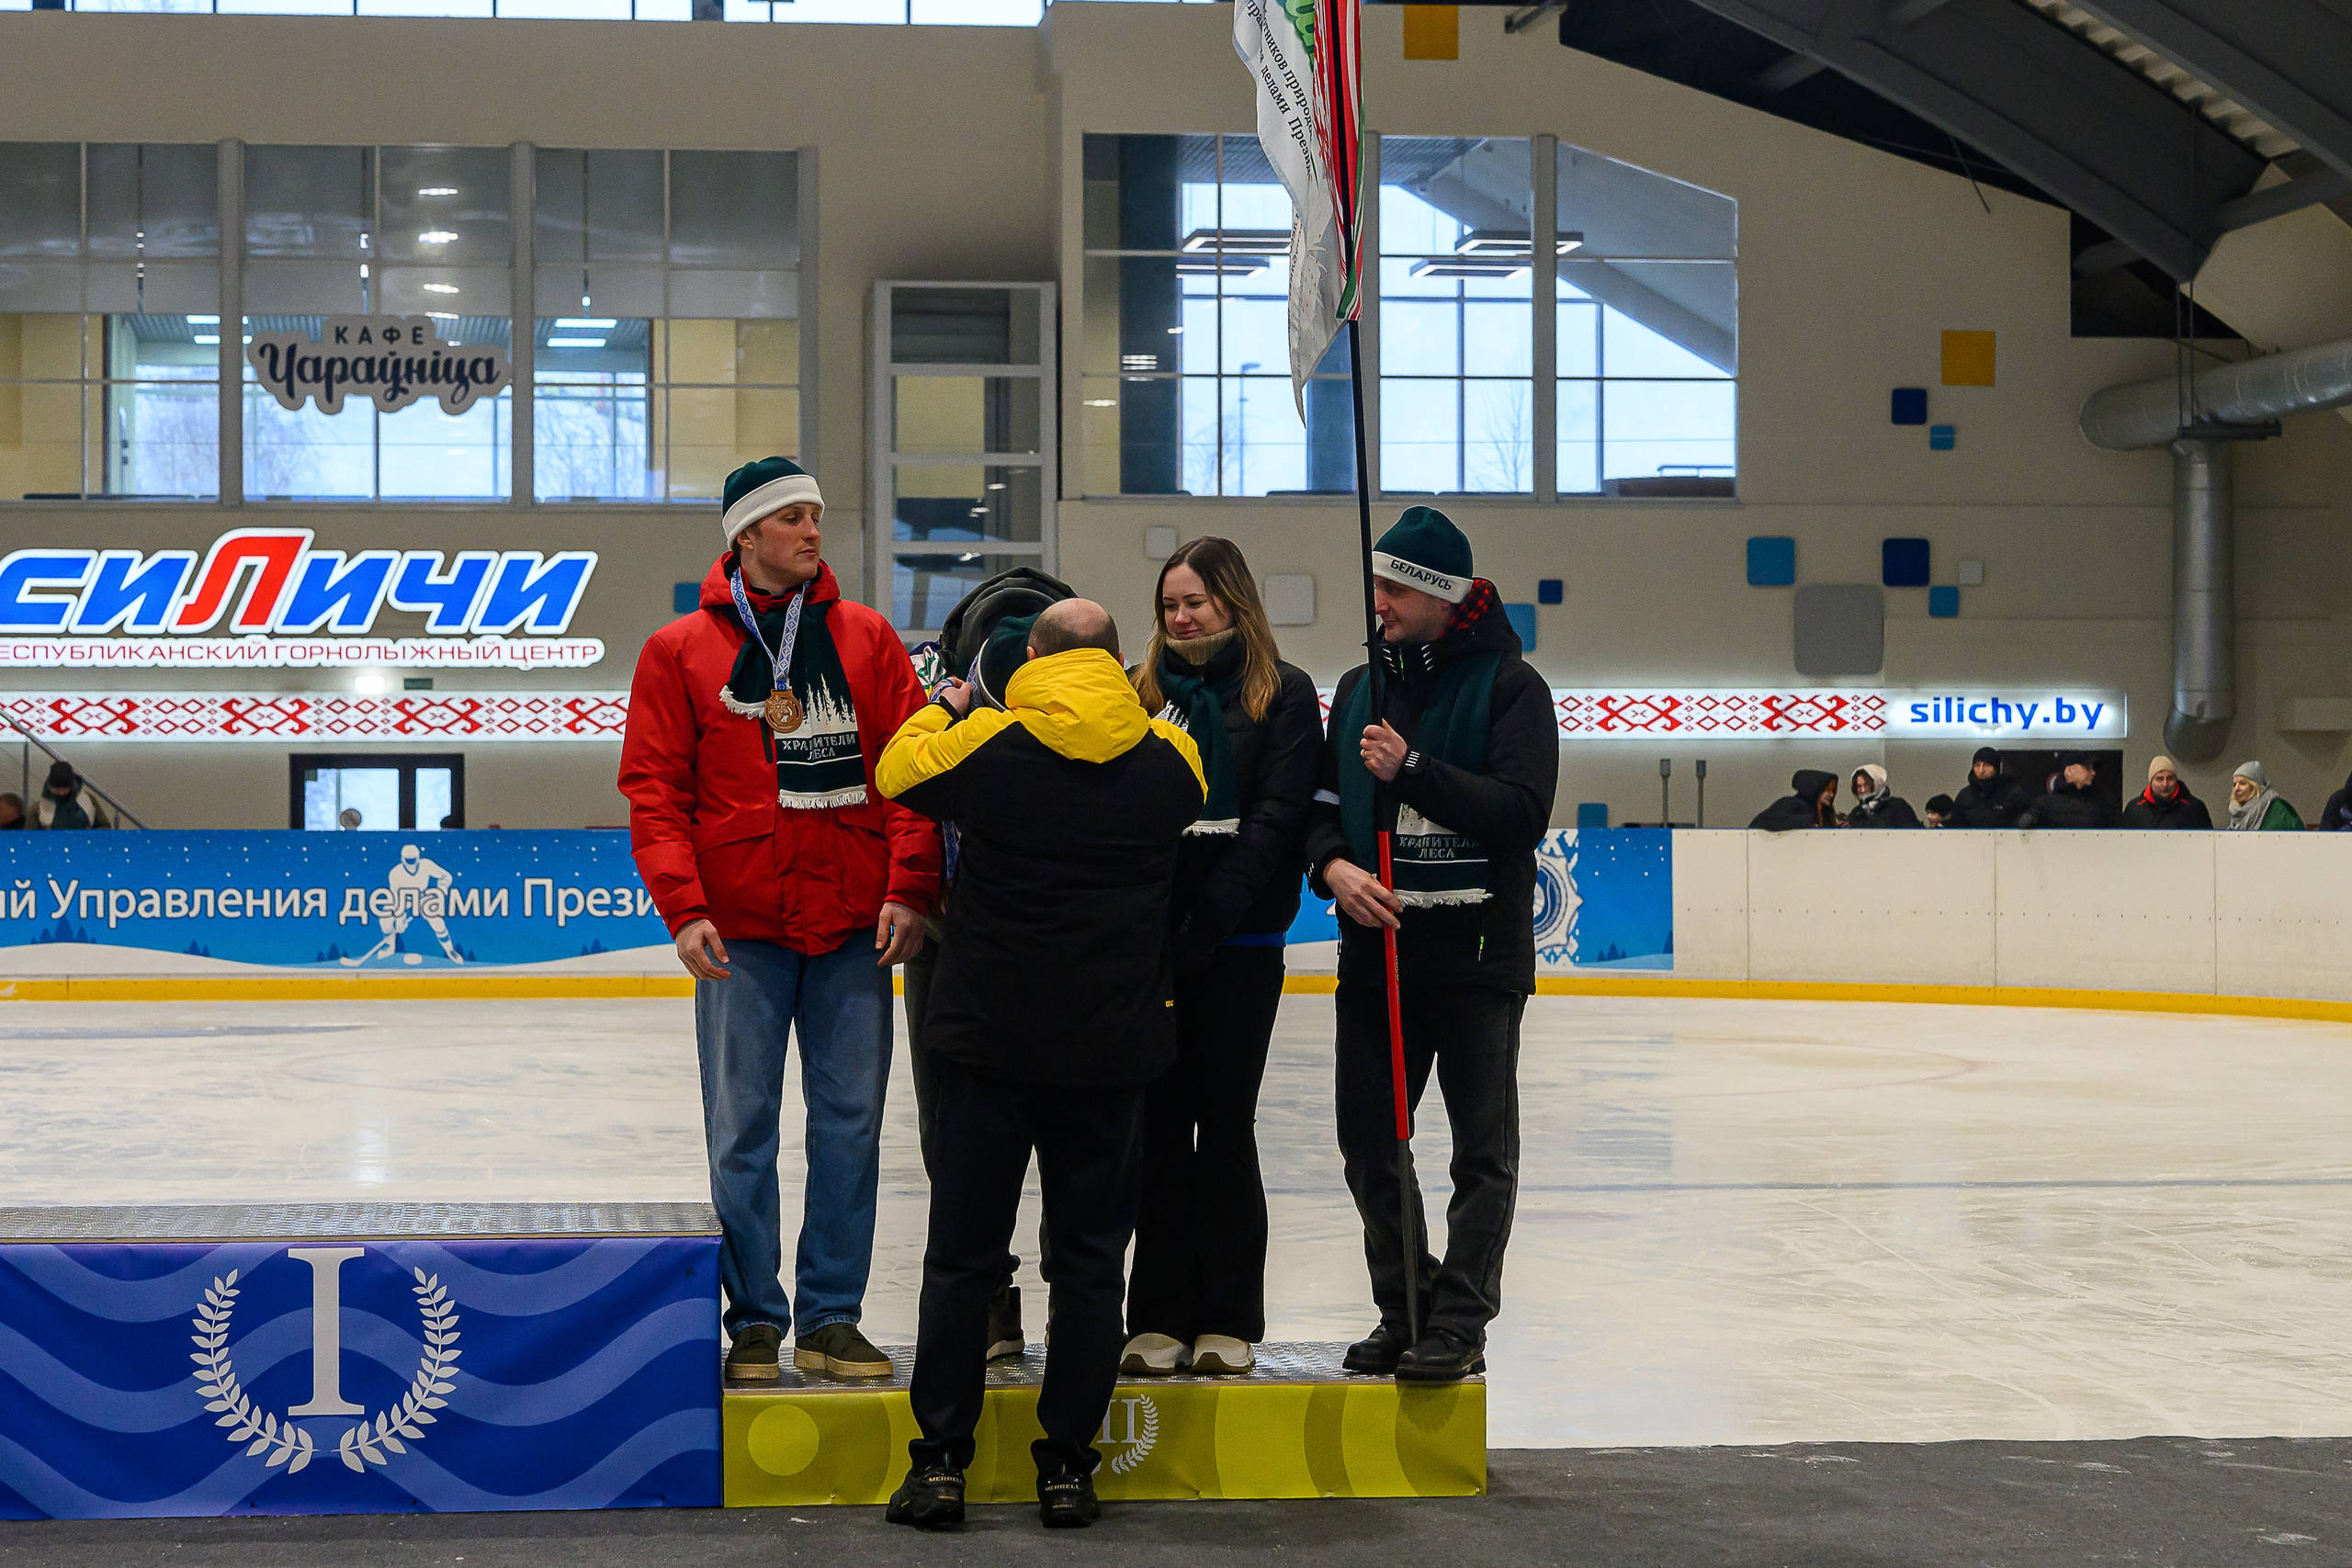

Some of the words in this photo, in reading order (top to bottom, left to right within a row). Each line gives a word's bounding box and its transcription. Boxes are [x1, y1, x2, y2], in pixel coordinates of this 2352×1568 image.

[1261, 65, 1292, 115] делами
[334, 325, 424, 345] КАФЕ
[258, 343, 501, 405] Чараўніца
[1390, 559, 1453, 591] БЕЛАРУСЬ
[276, 641, 502, 660] ГОРНОЛЫЖНЫЙ
[510, 644, 597, 663] ЦЕНТР
[1910, 696, 2104, 730] silichy.by
[1419, 848, 1455, 859] ЛЕСА
[48, 878, 328, 930] Управления
[339, 886, 509, 926] делами
[524, 877, 664, 928] Прези
